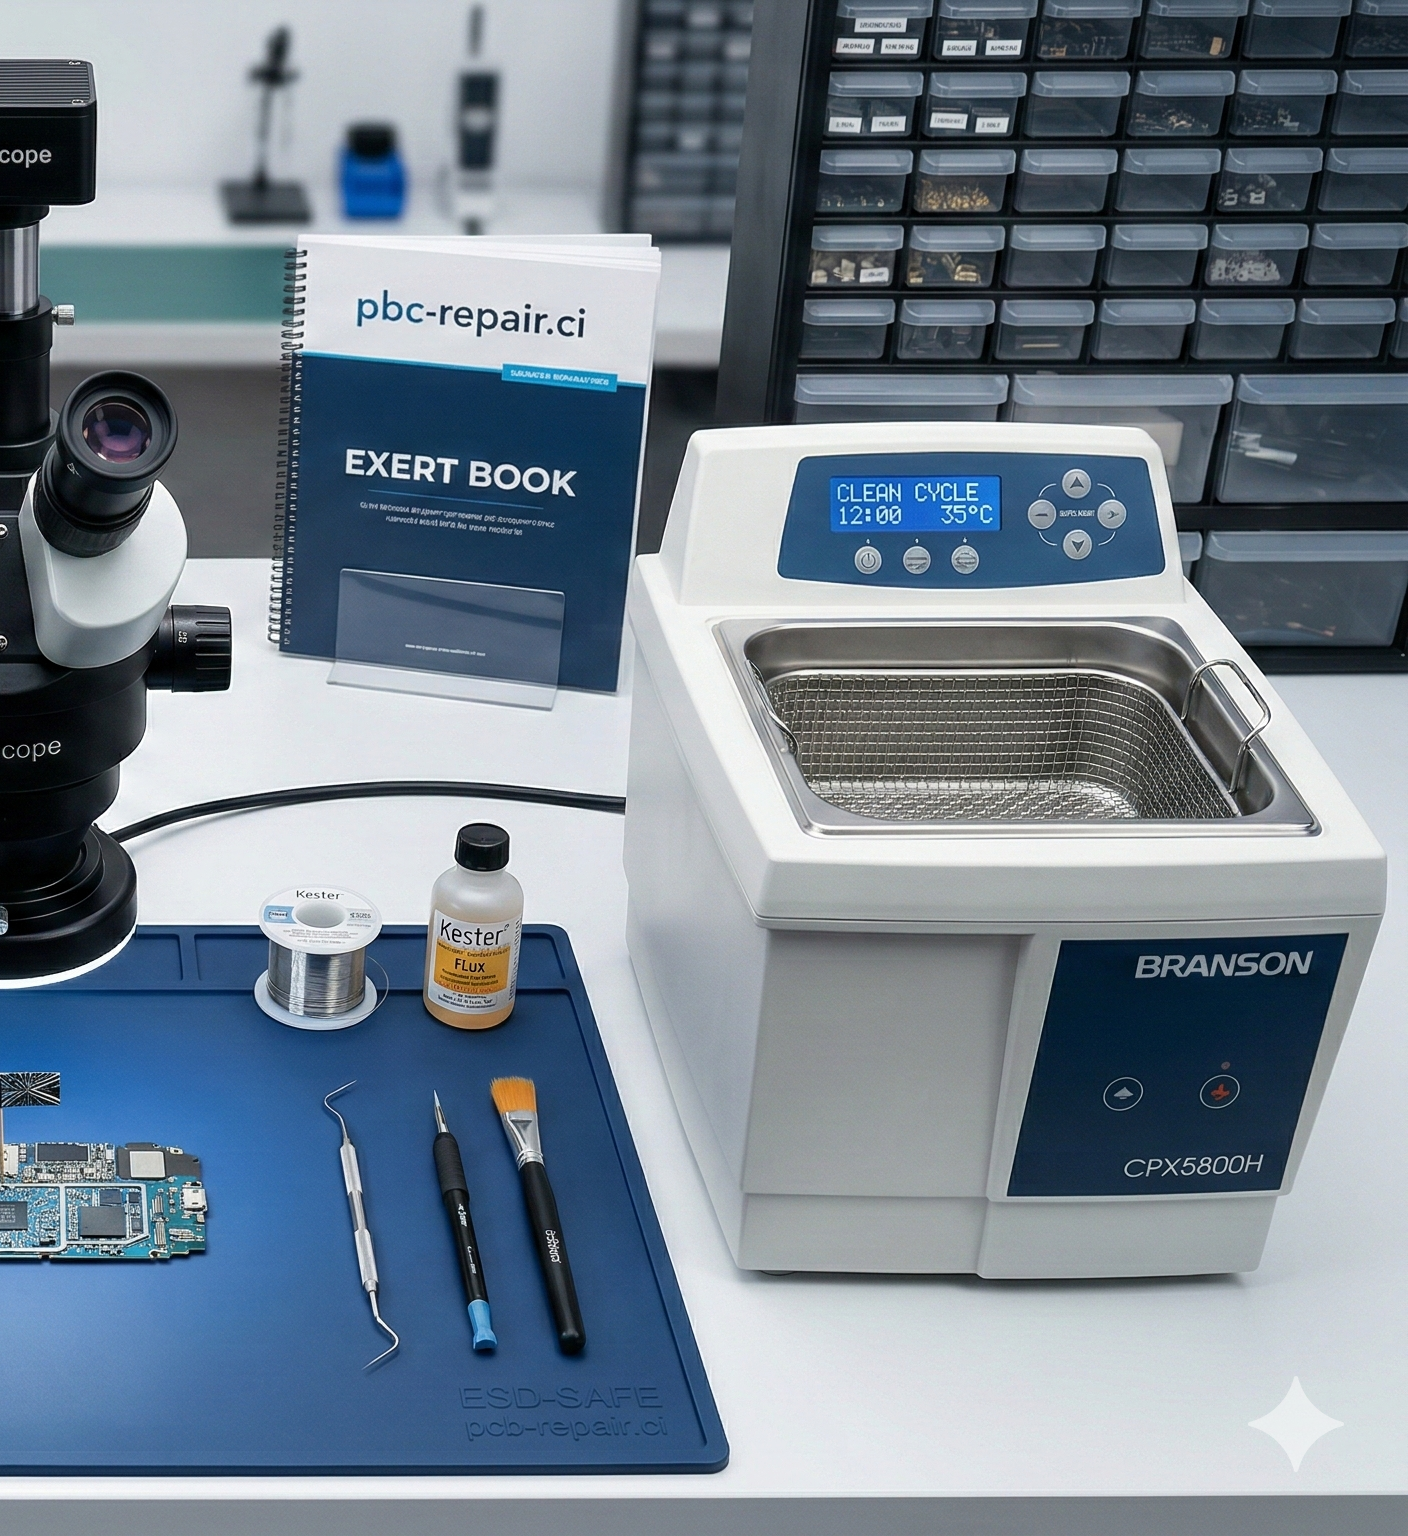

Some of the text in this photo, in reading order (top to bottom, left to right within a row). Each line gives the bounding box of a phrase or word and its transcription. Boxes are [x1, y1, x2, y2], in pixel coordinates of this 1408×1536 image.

[356, 289, 586, 338] pbc-repair.ci
[345, 448, 578, 497] EXERT BOOK
[837, 483, 979, 502] CLEAN CYCLE
[839, 505, 993, 525] 12:00 35°C
[296, 889, 341, 900] Kester
[440, 918, 505, 946] Kester
[1134, 951, 1314, 979] BRANSON
[1123, 1154, 1265, 1178] CPX5800H
[458, 1387, 664, 1410] ESD-SAFE
[465, 1416, 668, 1442] pcb-repair.ci
